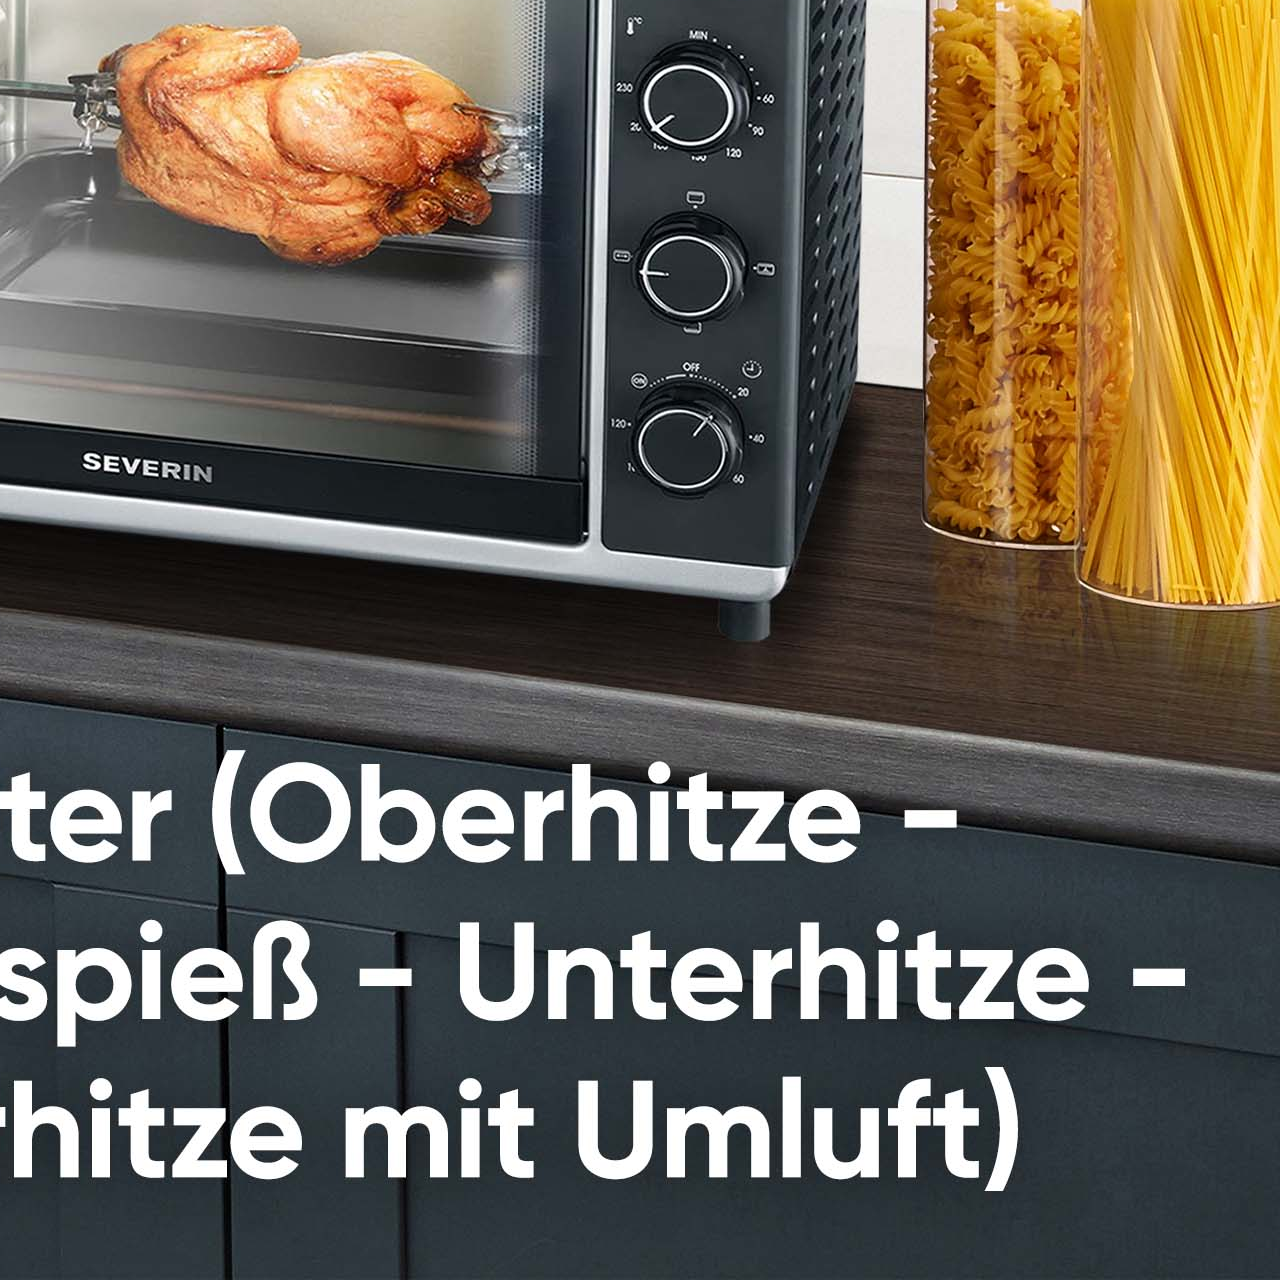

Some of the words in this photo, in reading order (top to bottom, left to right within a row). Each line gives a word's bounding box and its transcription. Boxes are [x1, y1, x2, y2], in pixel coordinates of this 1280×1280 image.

[689, 30, 708, 40] MIN
[616, 82, 633, 93] 230
[762, 94, 775, 104] 60
[752, 126, 765, 136] 90
[726, 147, 742, 158] 120
[682, 361, 701, 372] OFF
[738, 387, 750, 397] 20
[611, 418, 627, 429] 120
[752, 433, 765, 444] 40
[82, 452, 213, 483] SEVERIN
[732, 474, 745, 484] 60
